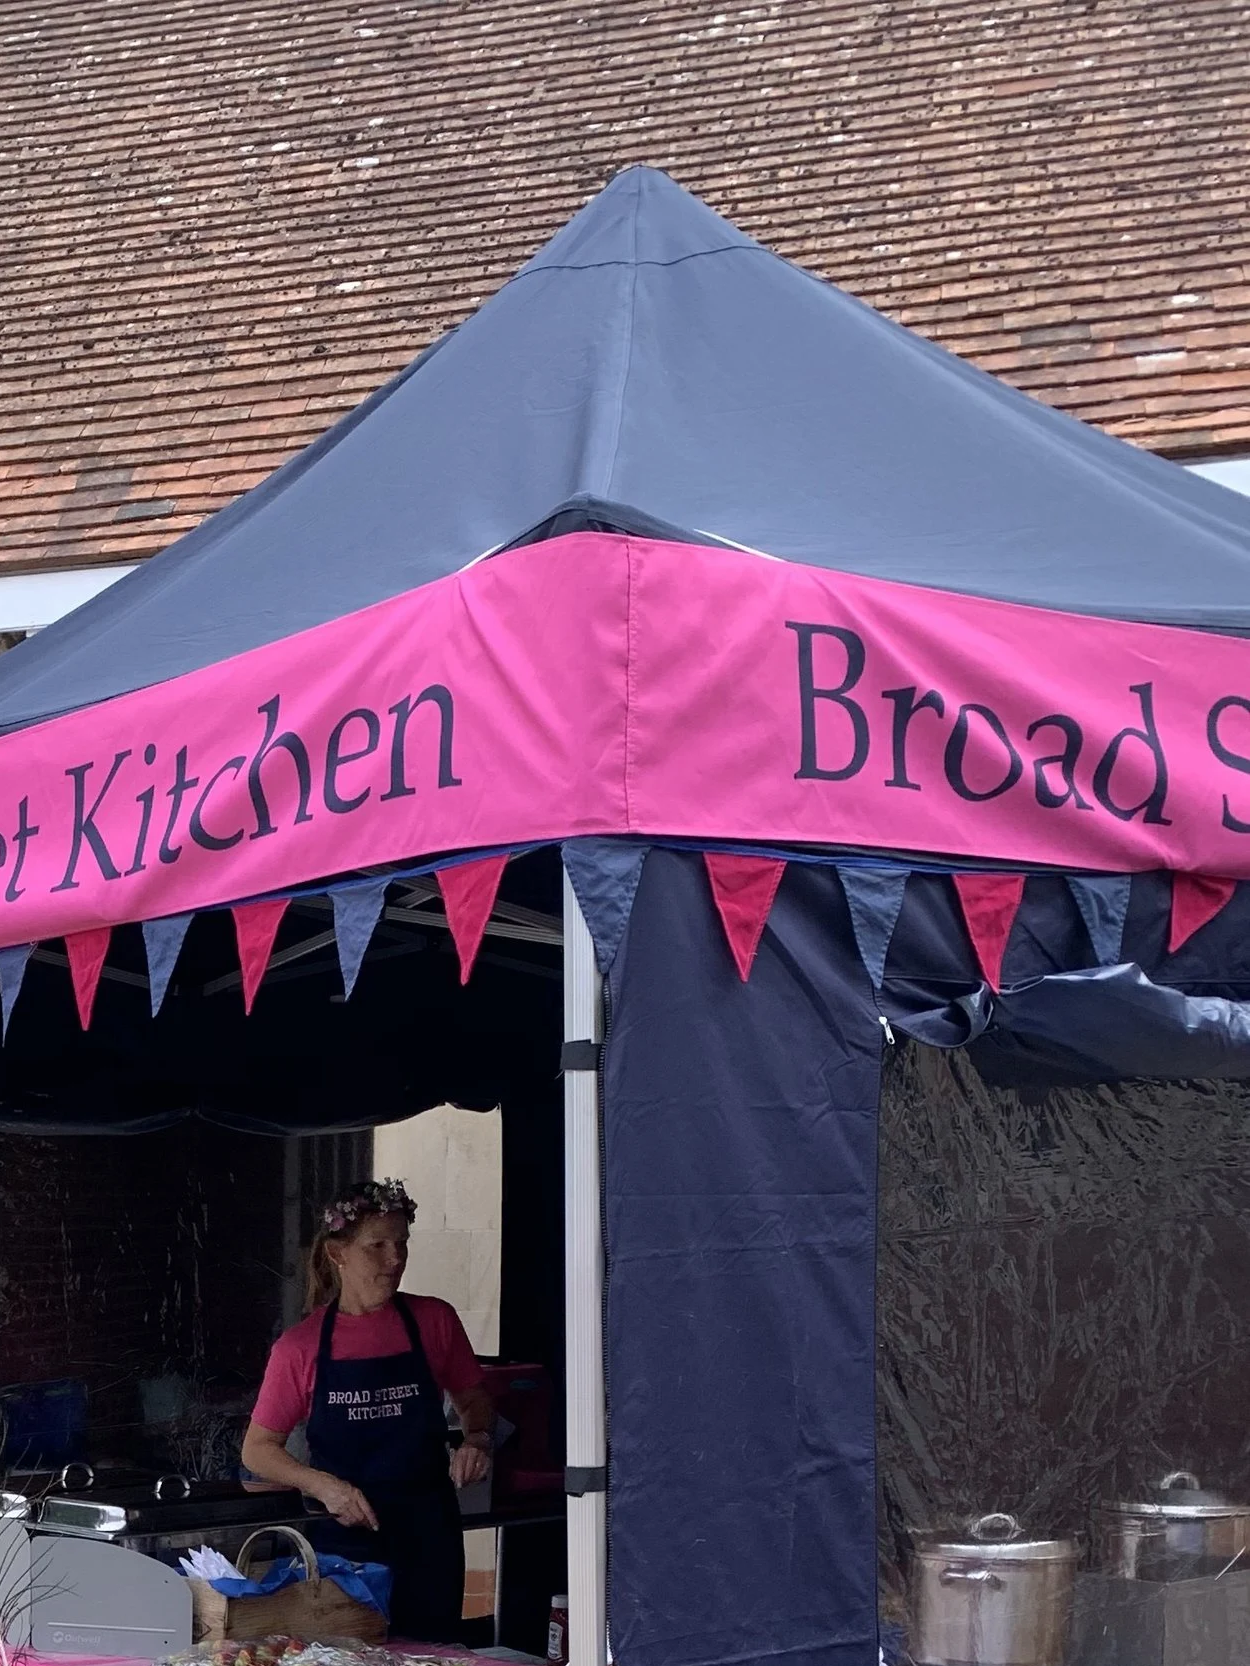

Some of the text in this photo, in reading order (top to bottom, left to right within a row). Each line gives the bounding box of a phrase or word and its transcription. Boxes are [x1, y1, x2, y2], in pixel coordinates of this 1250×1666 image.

[785, 620, 1172, 827] Broad
[50, 684, 462, 891] Kitchen
[328, 1384, 420, 1404] BROAD STREET
[348, 1403, 402, 1420] KITCHEN
